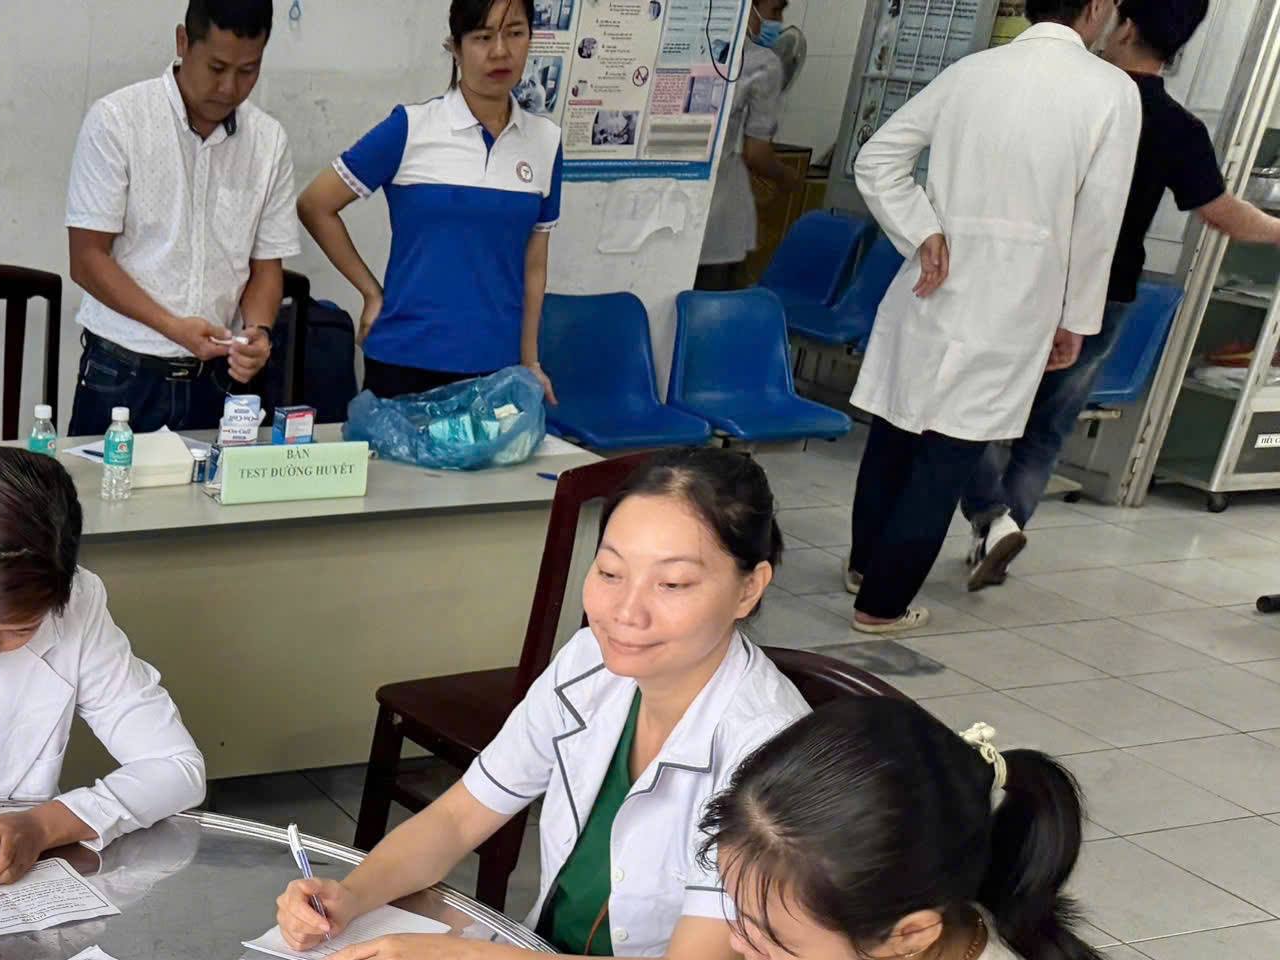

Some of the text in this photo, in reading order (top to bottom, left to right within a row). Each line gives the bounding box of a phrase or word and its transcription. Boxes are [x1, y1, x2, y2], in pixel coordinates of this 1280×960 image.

[286, 446, 311, 460] BÀN
[239, 461, 355, 479] TEST ĐƯỜNG HUYẾT
